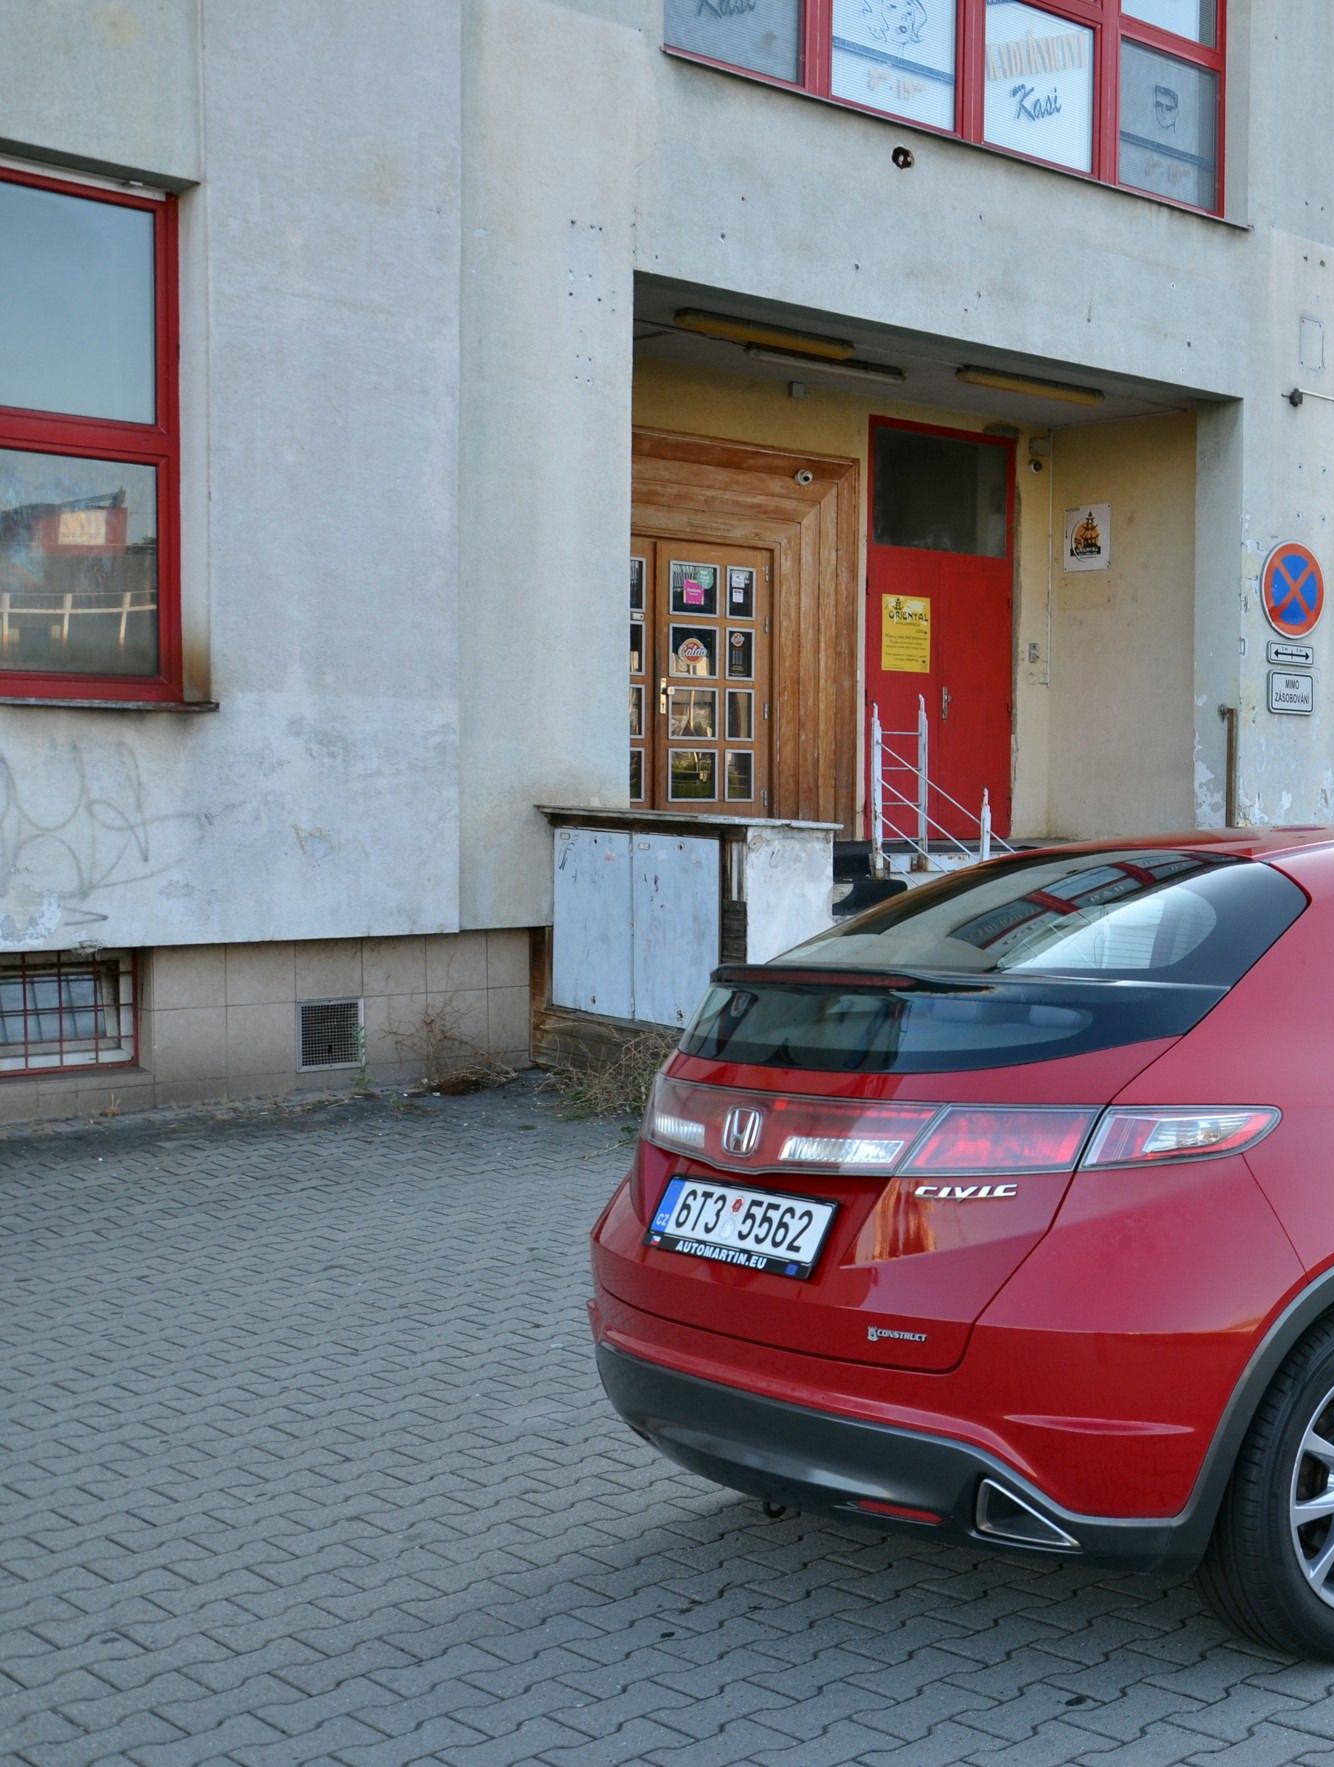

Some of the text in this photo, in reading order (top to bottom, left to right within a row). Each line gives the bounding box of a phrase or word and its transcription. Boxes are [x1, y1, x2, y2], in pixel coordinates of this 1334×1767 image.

[889, 610, 928, 622] ORIENTAL
[1285, 679, 1300, 690] MIMO
[914, 1183, 1018, 1200] CIVIC
[655, 1213, 670, 1227] CZ
[675, 1188, 814, 1254] 6T3 5562
[675, 1240, 768, 1270] AUTOMARTIN.EU
[877, 1328, 928, 1342] CONSTRUCT
